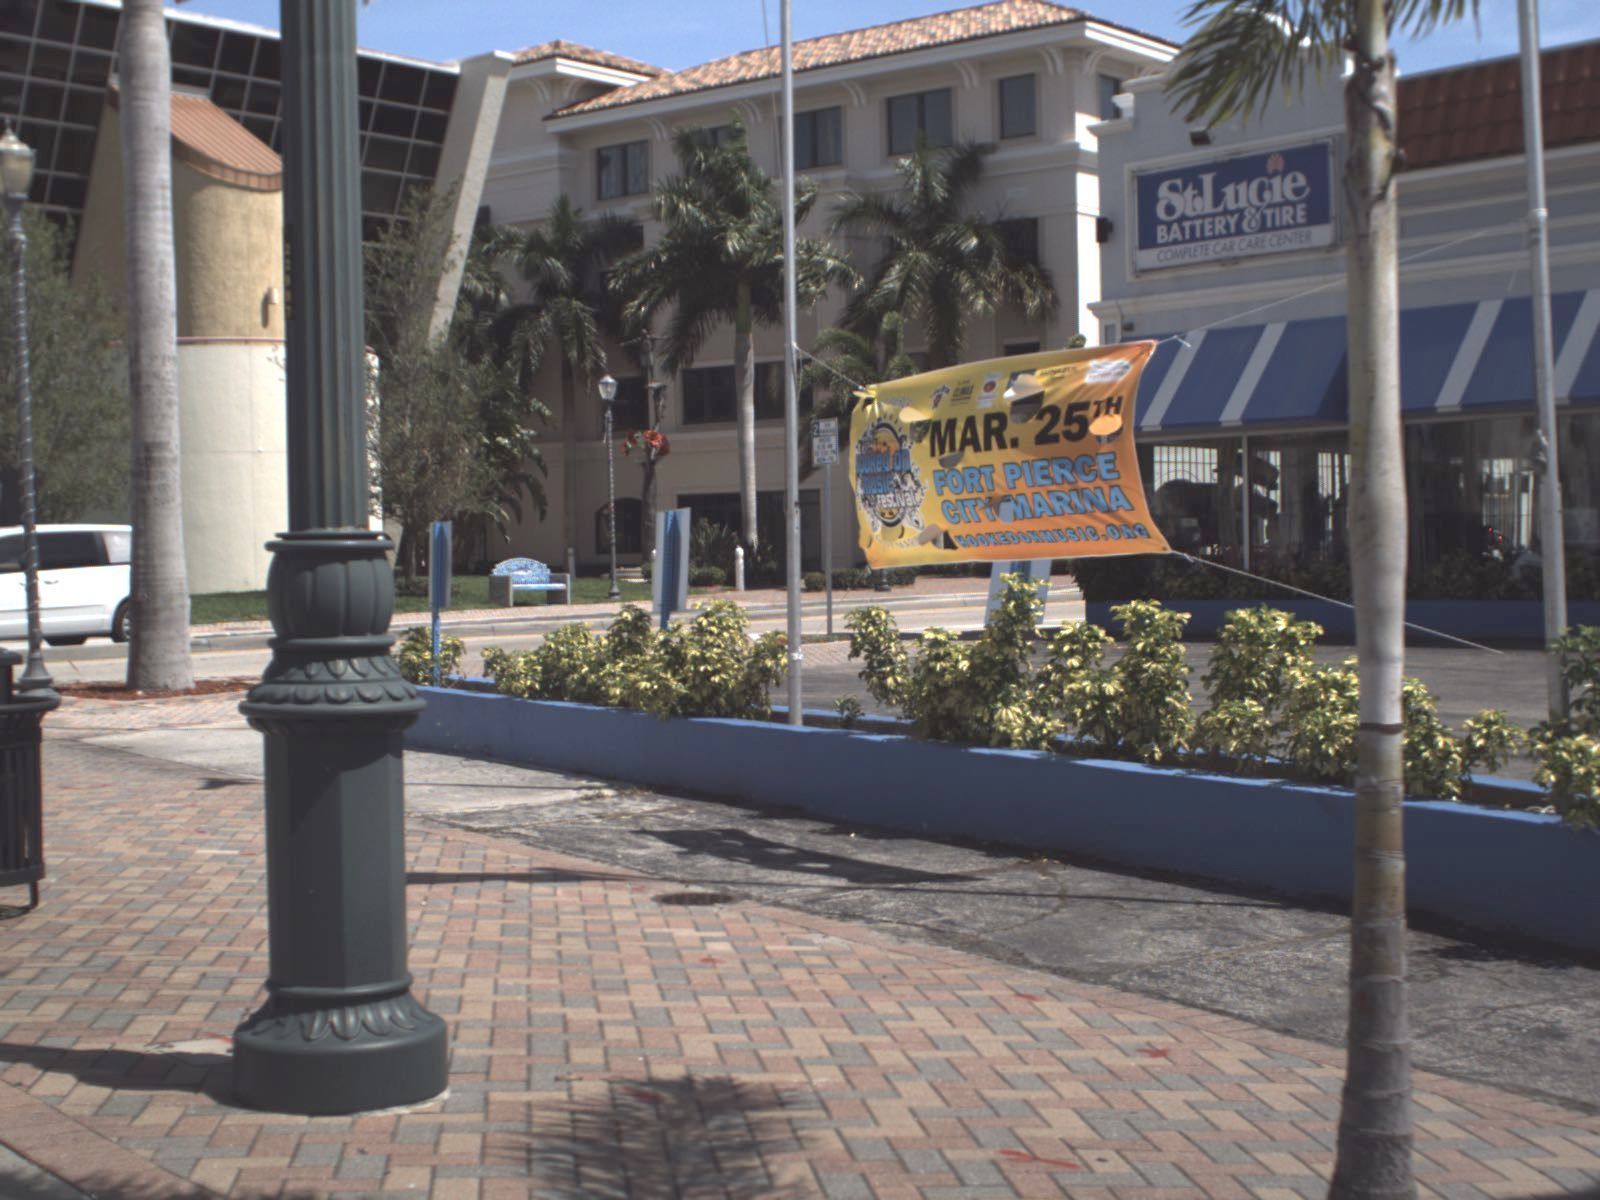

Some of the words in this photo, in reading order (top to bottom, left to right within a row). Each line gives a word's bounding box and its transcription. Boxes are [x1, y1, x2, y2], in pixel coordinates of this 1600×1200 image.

[1156, 213, 1240, 244] BATTERY
[1241, 203, 1267, 233] &
[1264, 203, 1307, 227] TIRE
[1157, 243, 1210, 263] COMPLETE
[1211, 238, 1236, 256] CAR
[1239, 234, 1266, 252] CARE
[1268, 229, 1313, 248] CENTER
[929, 411, 1020, 458] MAR.
[933, 464, 995, 496] FORT
[1003, 451, 1121, 490] PIERCE
[941, 496, 996, 525] CITY
[1003, 484, 1135, 522] MARINA
